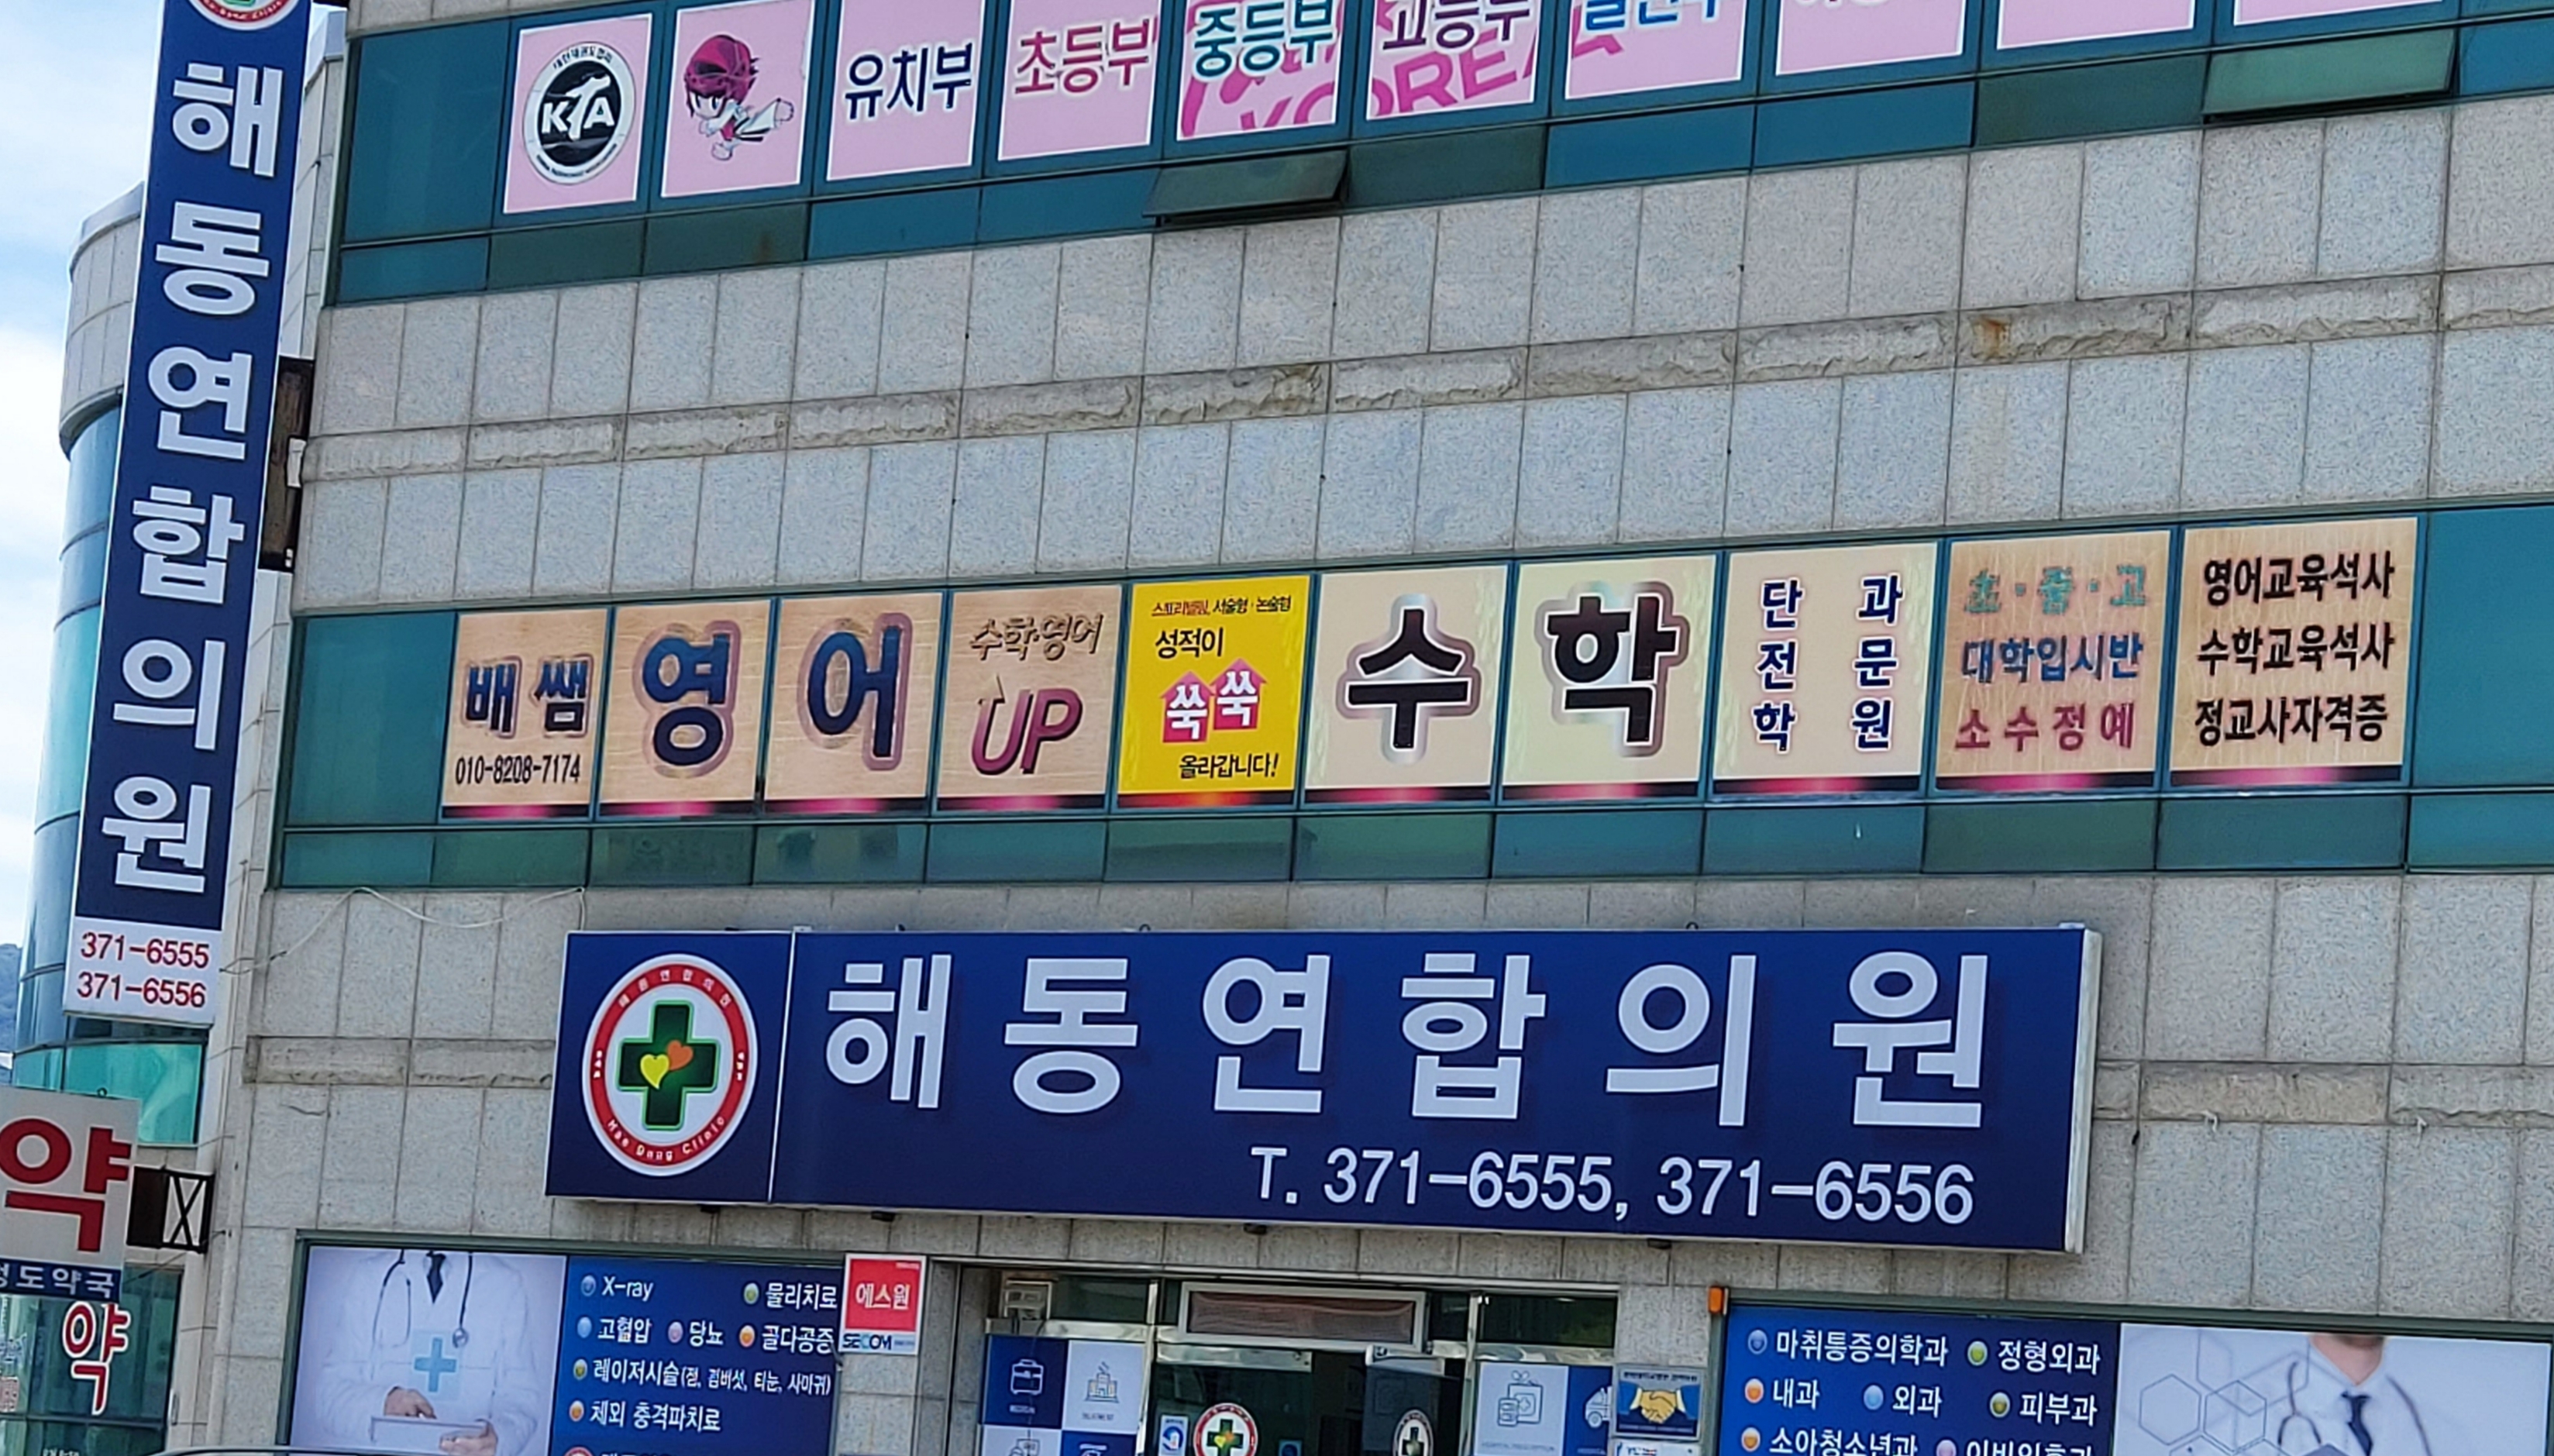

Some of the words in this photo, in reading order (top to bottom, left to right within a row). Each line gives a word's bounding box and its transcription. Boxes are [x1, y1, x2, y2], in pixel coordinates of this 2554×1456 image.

[1014, 17, 1150, 95] 초등부
[1194, 0, 1334, 77] 중등부
[845, 42, 972, 120] 유치부
[102, 63, 284, 893] 해동연합의원
[2203, 551, 2396, 607] 영어교육석사
[1155, 627, 1224, 659] 성적이
[1961, 632, 2144, 684] 대학입시반
[2198, 622, 2396, 676] 수학교육석사
[642, 625, 901, 766] 영어
[972, 687, 1083, 776] UP
[1955, 702, 2134, 752] 소수정예
[2194, 694, 2389, 746] 정교사자격증
[456, 753, 580, 784] 010-8208-7174
[1179, 752, 1279, 780] 올라갑니다!
[81, 931, 209, 969] 371-6555
[76, 972, 207, 1008] 371-6556
[826, 952, 1989, 1128] 해동연합의원
[0, 1118, 133, 1253] 약
[1251, 1146, 1298, 1205] T.
[1323, 1147, 1629, 1221] 371-6555,
[1657, 1156, 1974, 1224] 371-6556
[601, 1275, 654, 1303] X-ray
[766, 1282, 838, 1311] 물리치료
[855, 1282, 910, 1311] 에스원
[597, 1317, 652, 1344] 고혈압
[689, 1320, 724, 1348] 당뇨
[762, 1324, 835, 1354] 골다공증
[842, 1333, 893, 1351] SECOM
[1775, 1328, 1949, 1367] 마취통증의학과
[63, 1301, 131, 1415] 약
[1998, 1340, 2101, 1375] 정형외과
[1771, 1378, 1820, 1410] 내과
[1891, 1385, 1943, 1418] 외과
[2019, 1392, 2098, 1427] 피부과
[589, 1399, 625, 1427] 체외
[633, 1401, 721, 1433] 충격파치료
[1768, 1427, 1919, 1456] 소아청소년과
